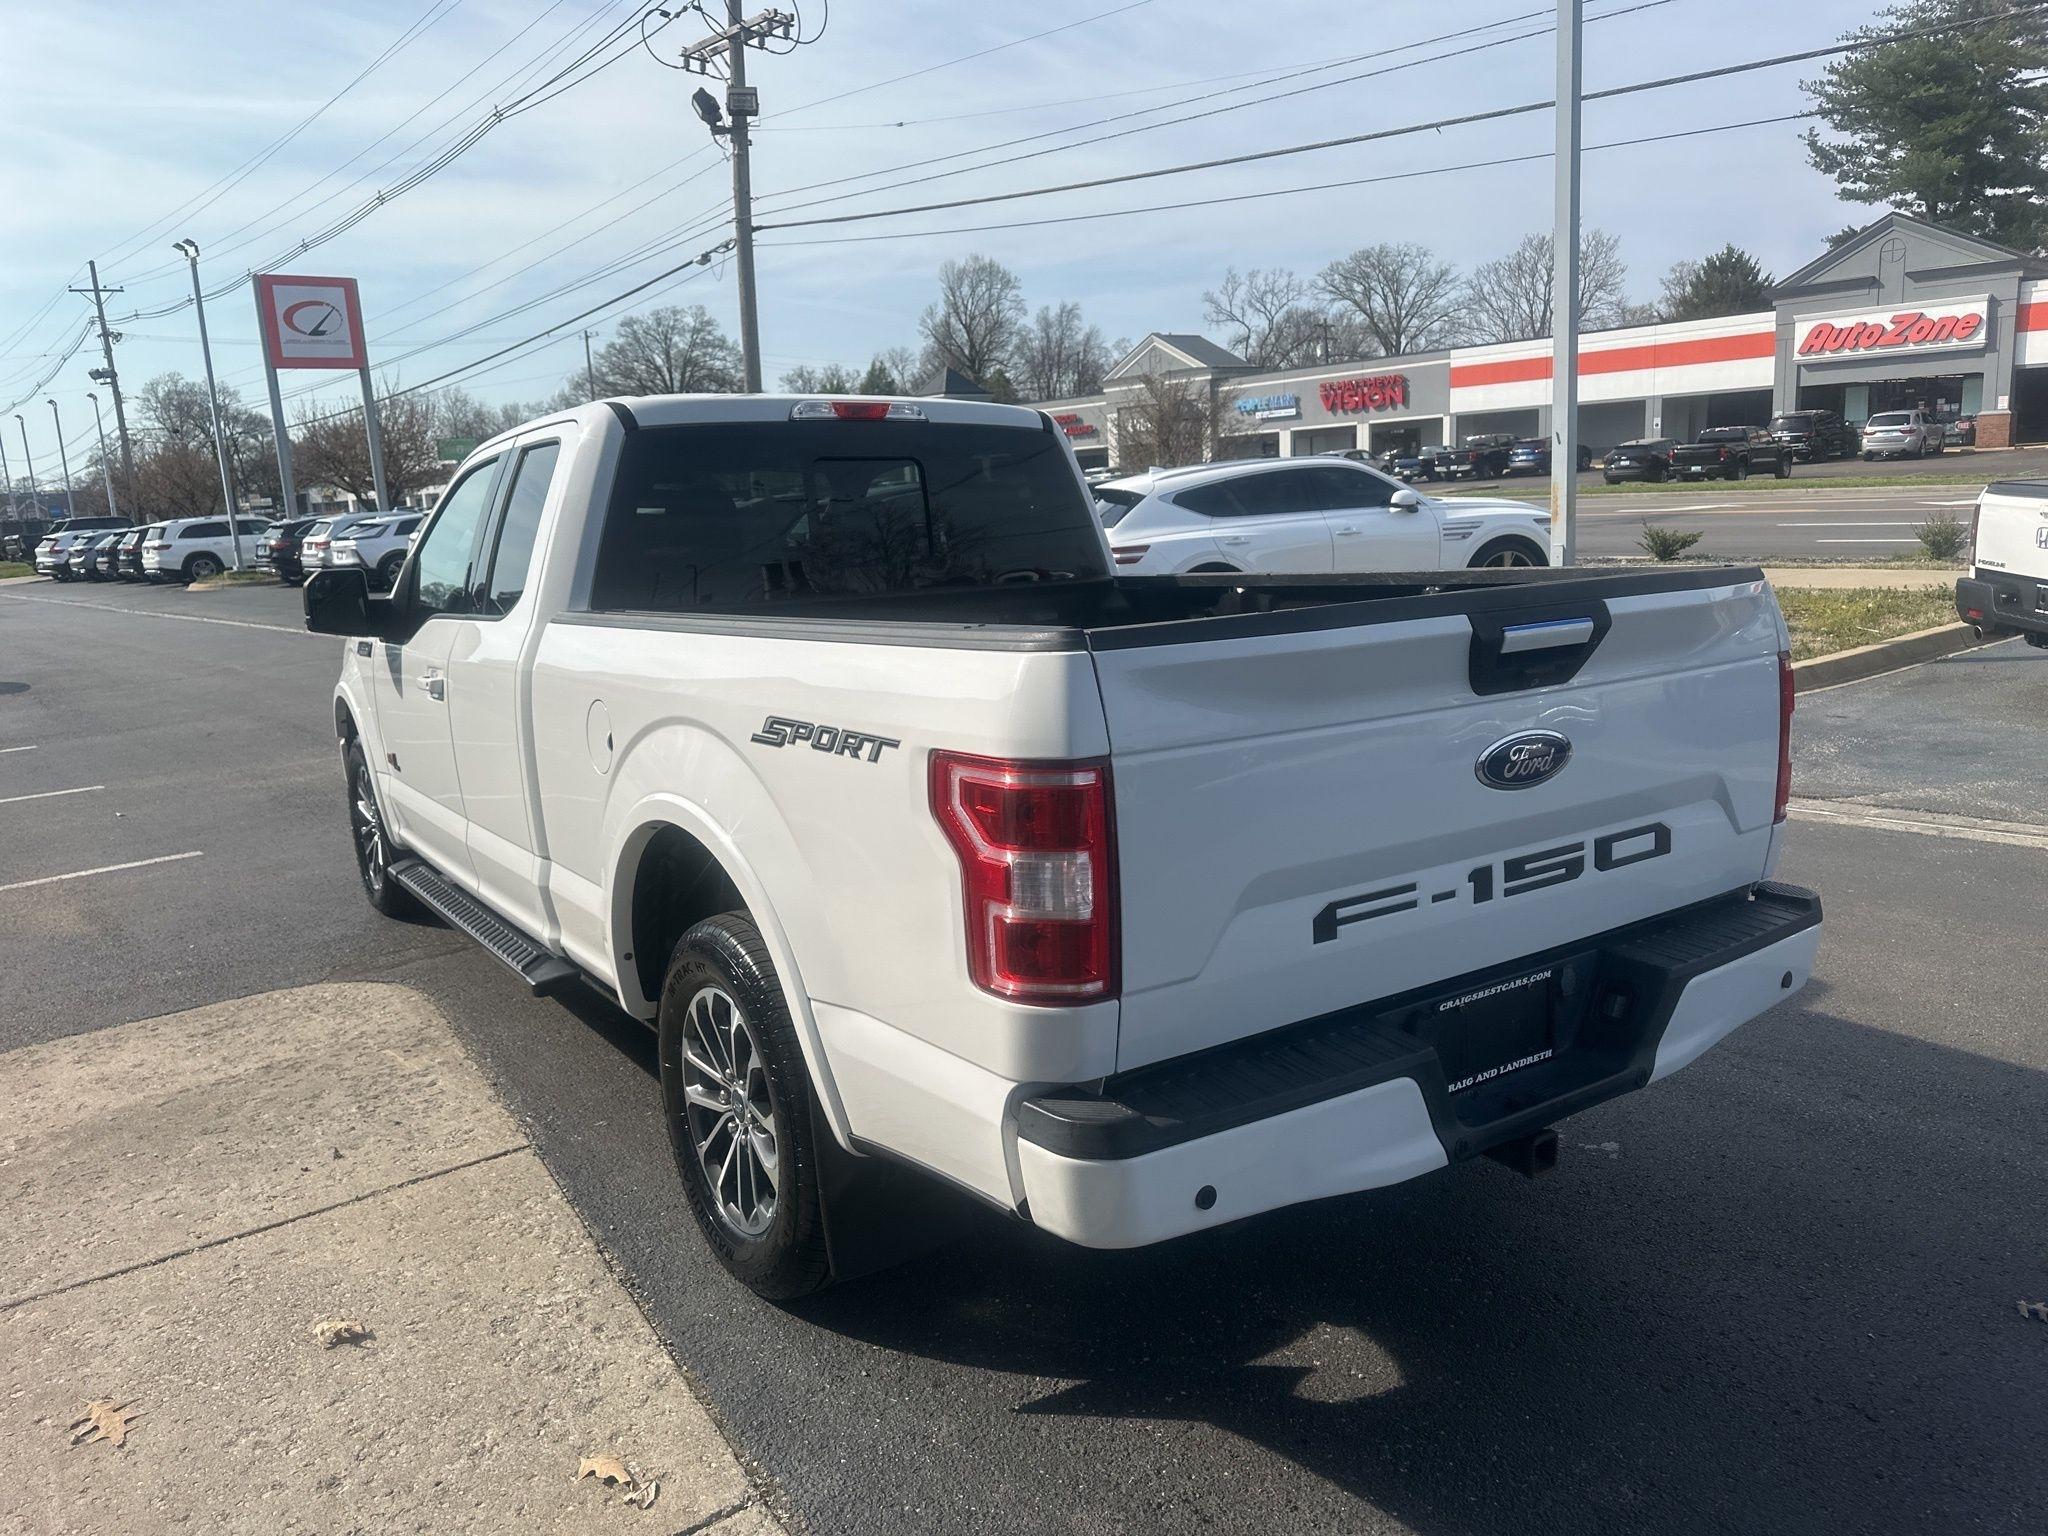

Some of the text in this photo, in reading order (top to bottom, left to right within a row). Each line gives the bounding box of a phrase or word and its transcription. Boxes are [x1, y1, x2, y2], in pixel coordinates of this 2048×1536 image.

[1797, 311, 1982, 356] AutoZone
[1320, 386, 1404, 412] VISION
[750, 715, 902, 764] SPORT
[1312, 821, 1672, 945] F-150
[1439, 970, 1552, 1011] CRAIGSBESTCARS.COM
[1448, 1049, 1553, 1093] RAIG AND LANDRETH
